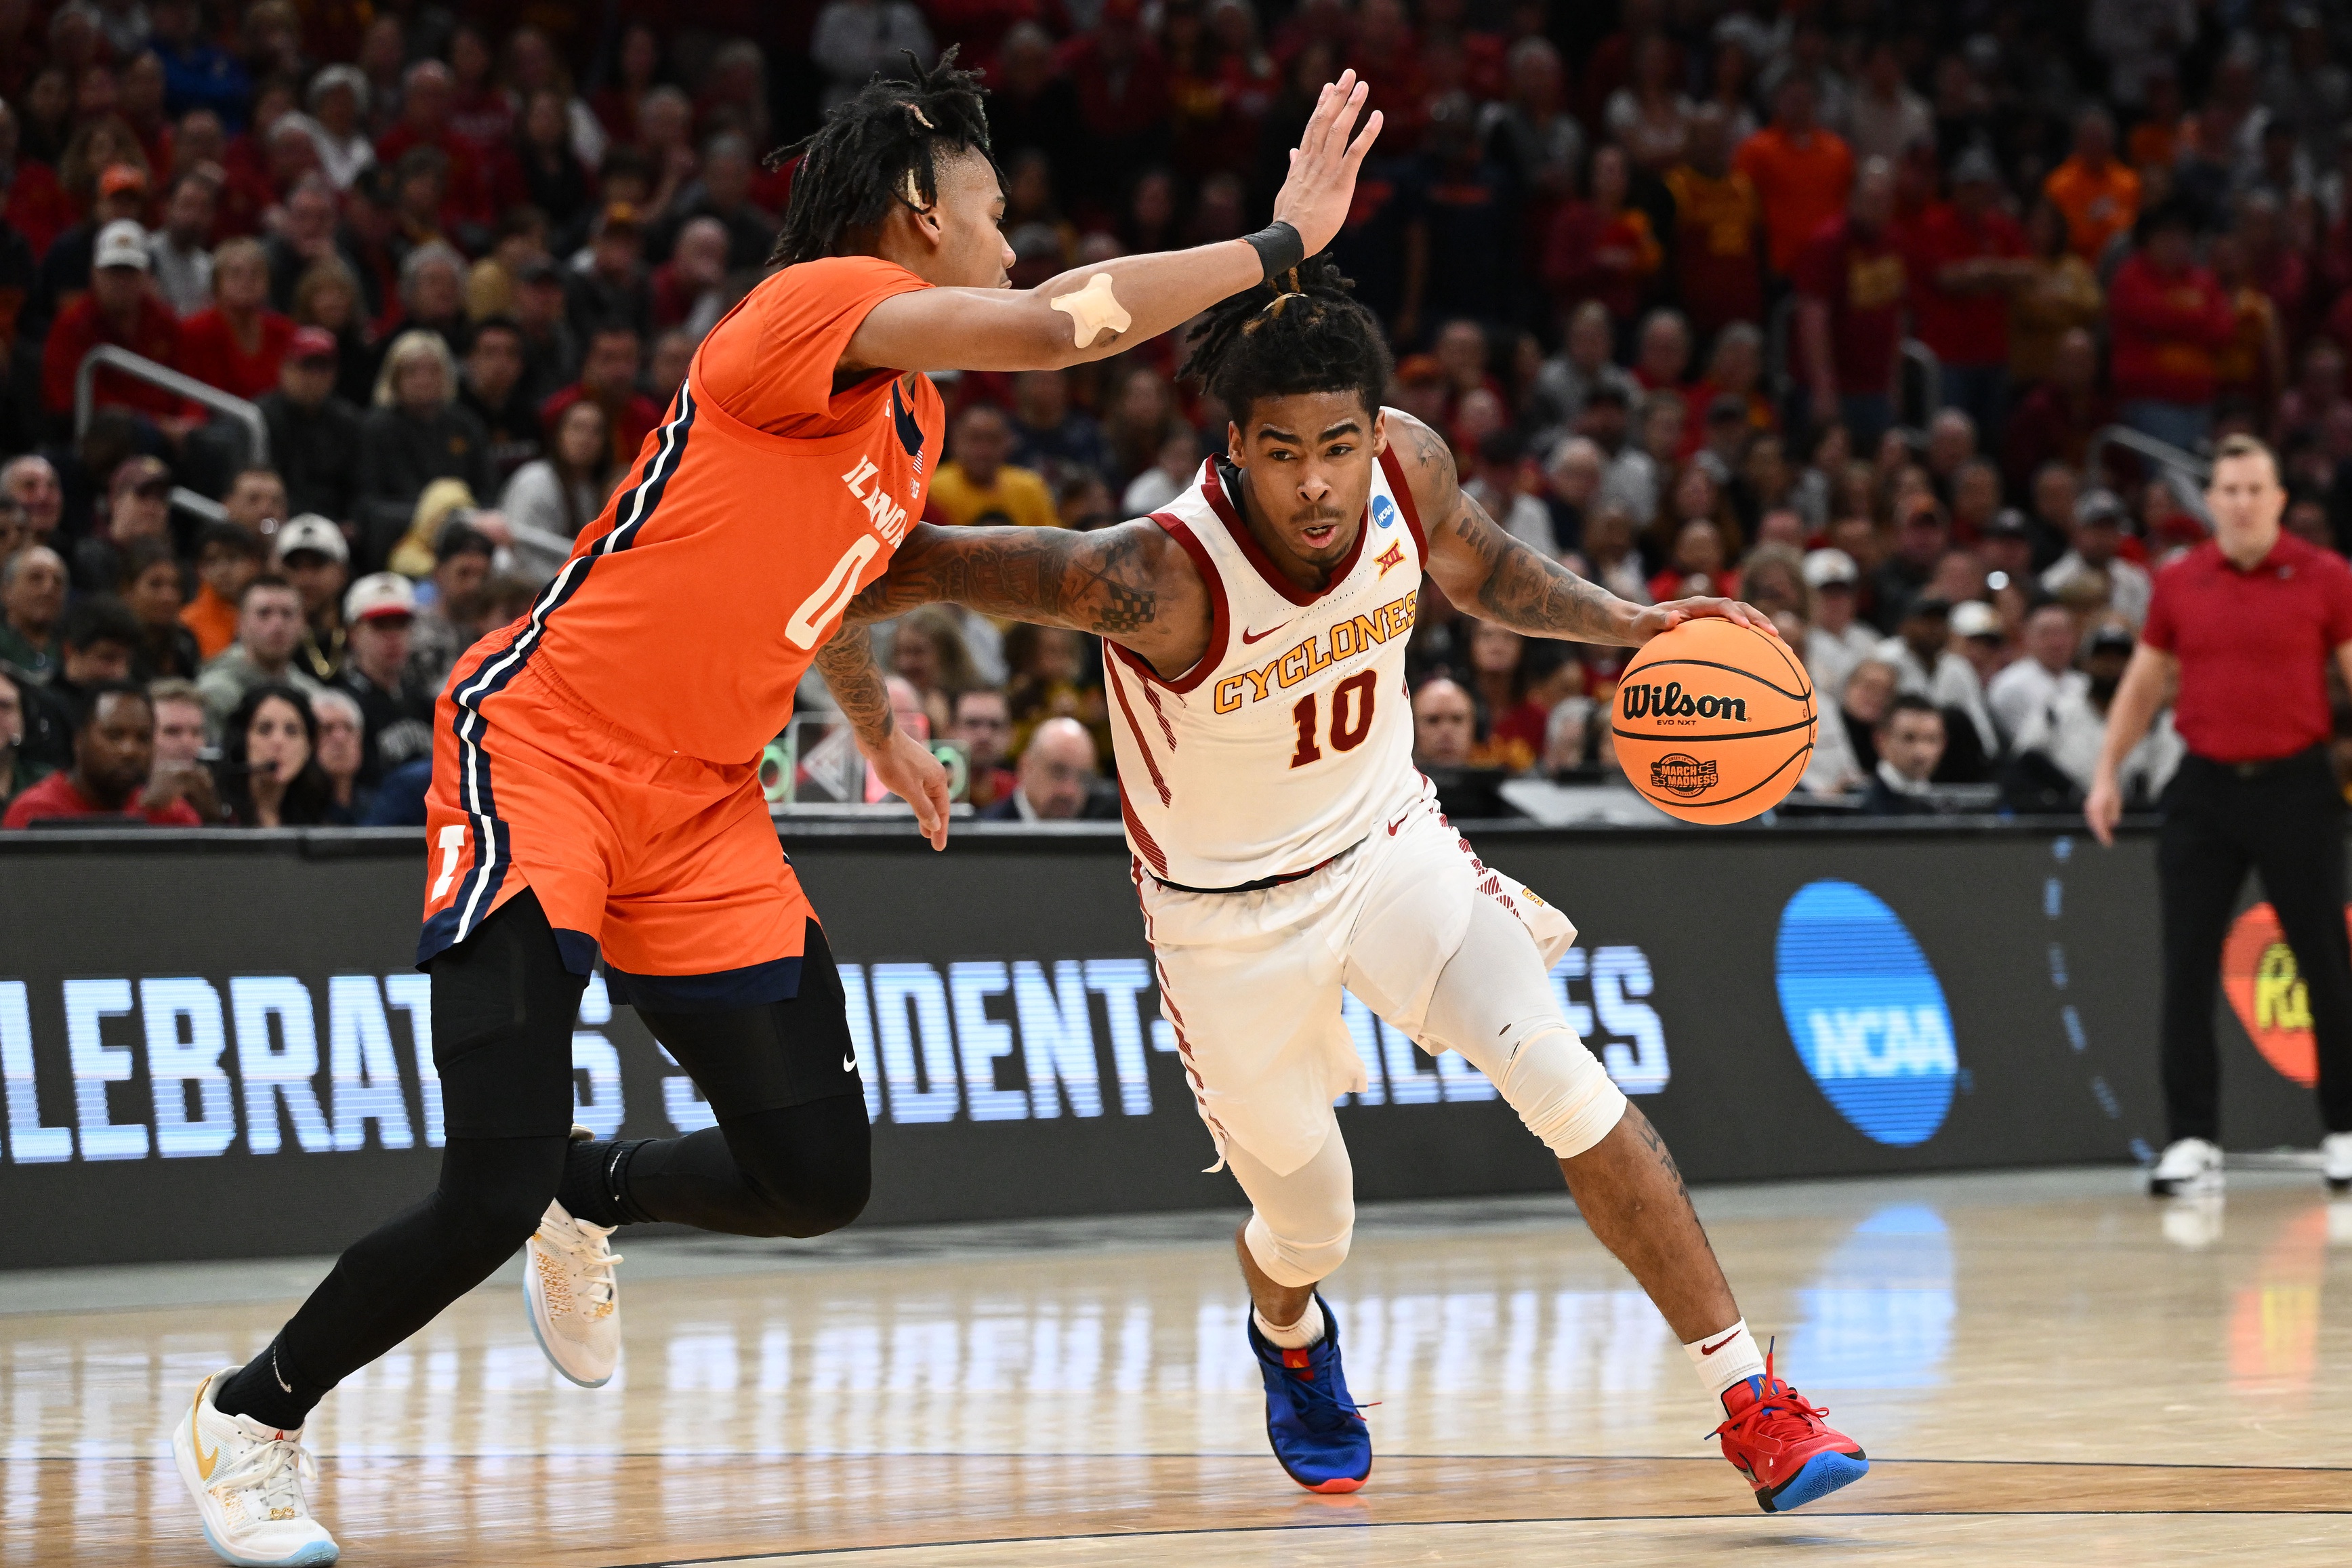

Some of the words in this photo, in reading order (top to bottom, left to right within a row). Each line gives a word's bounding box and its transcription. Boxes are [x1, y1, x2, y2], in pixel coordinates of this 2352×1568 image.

[1377, 504, 1394, 524] NCAA
[785, 533, 881, 651] 0
[1214, 590, 1416, 715] CYCLONES
[1289, 667, 1378, 770] 10
[1623, 682, 1747, 722] Wilson
[1661, 765, 1697, 777] MARCH
[1668, 773, 1717, 786] MADNESS
[0, 974, 625, 1165] LEBRATS
[1808, 1006, 1958, 1079] NCAA
